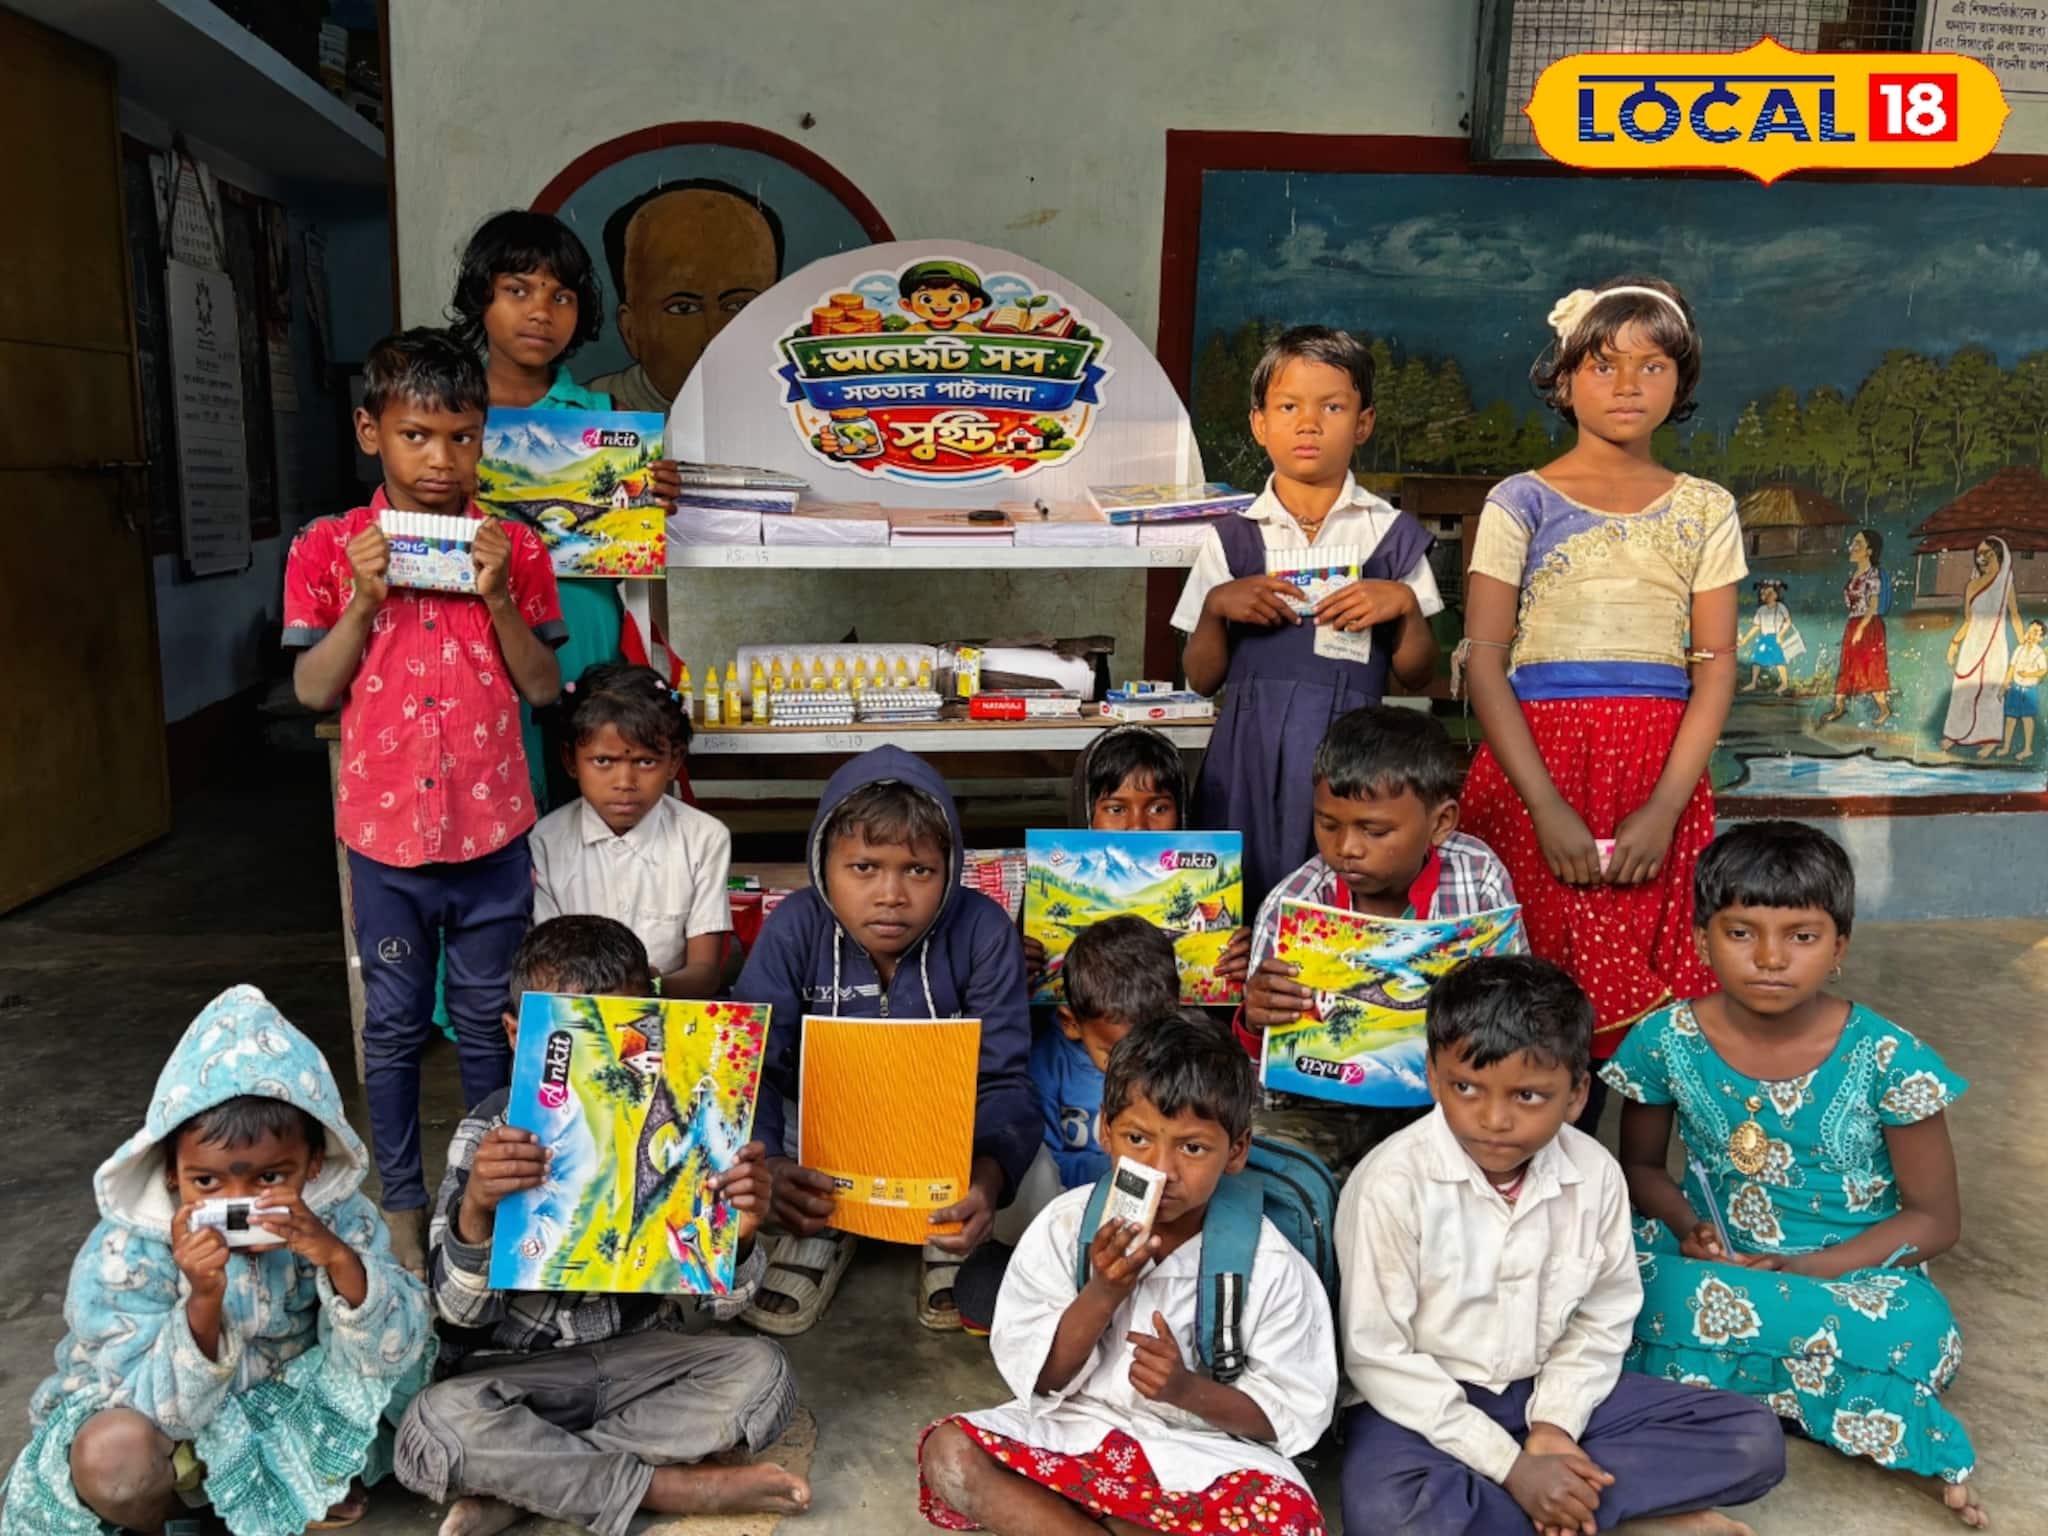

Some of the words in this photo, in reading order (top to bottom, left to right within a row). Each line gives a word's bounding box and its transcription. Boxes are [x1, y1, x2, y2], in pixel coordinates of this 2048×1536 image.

[841, 383, 929, 401] সততার
[935, 378, 1036, 402] পাঠশালা
[583, 430, 637, 447] Ankit
[1161, 852, 1214, 869] Ankit
[539, 1034, 571, 1106] Ankit
[1300, 1056, 1364, 1084] Ankit
